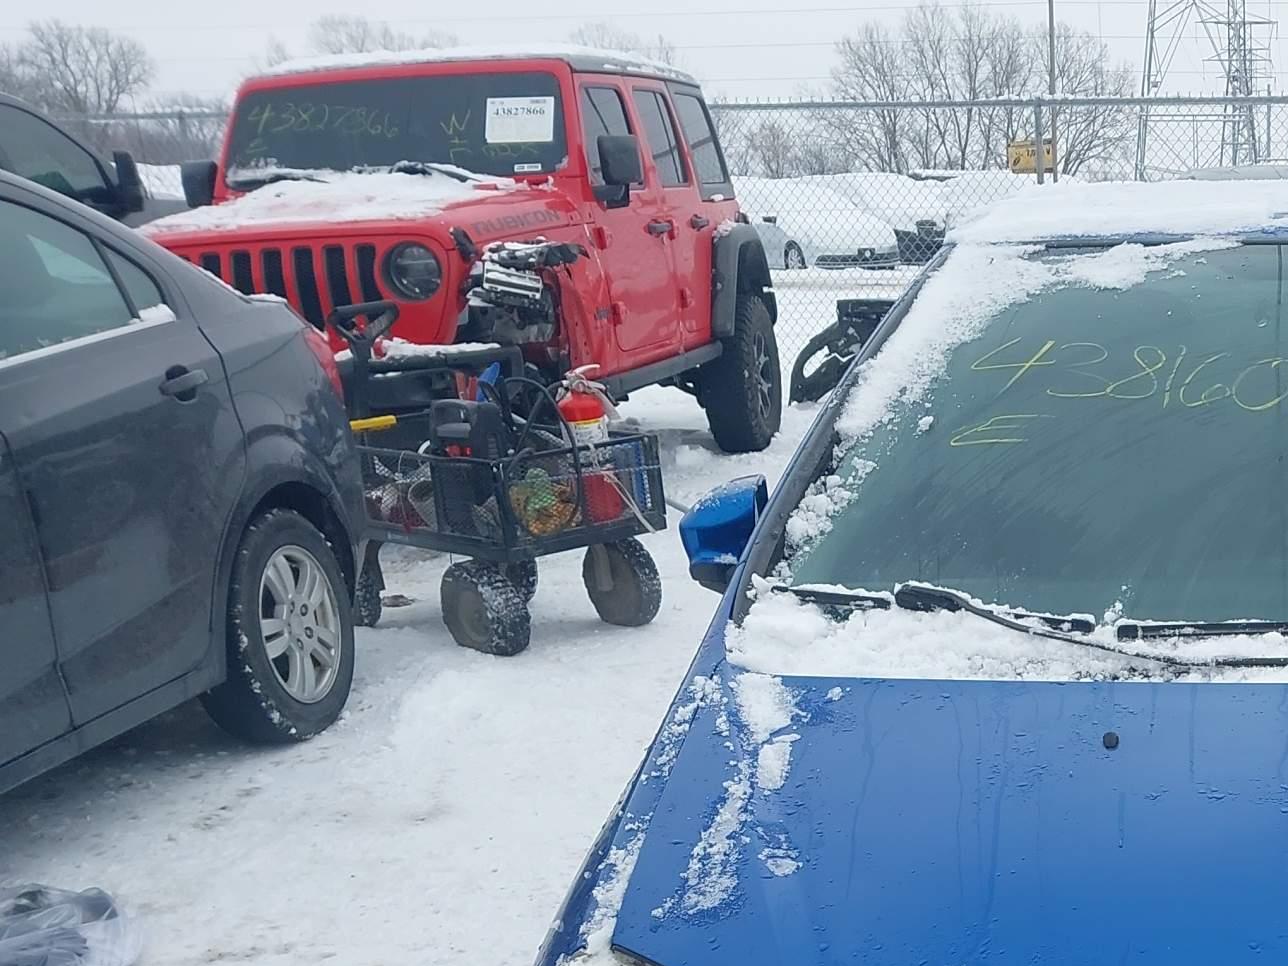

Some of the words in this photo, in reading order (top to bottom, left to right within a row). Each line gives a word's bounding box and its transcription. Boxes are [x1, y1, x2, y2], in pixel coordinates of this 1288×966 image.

[492, 107, 545, 117] 43827866
[471, 209, 561, 235] RUBICON
[950, 413, 1056, 446] E
